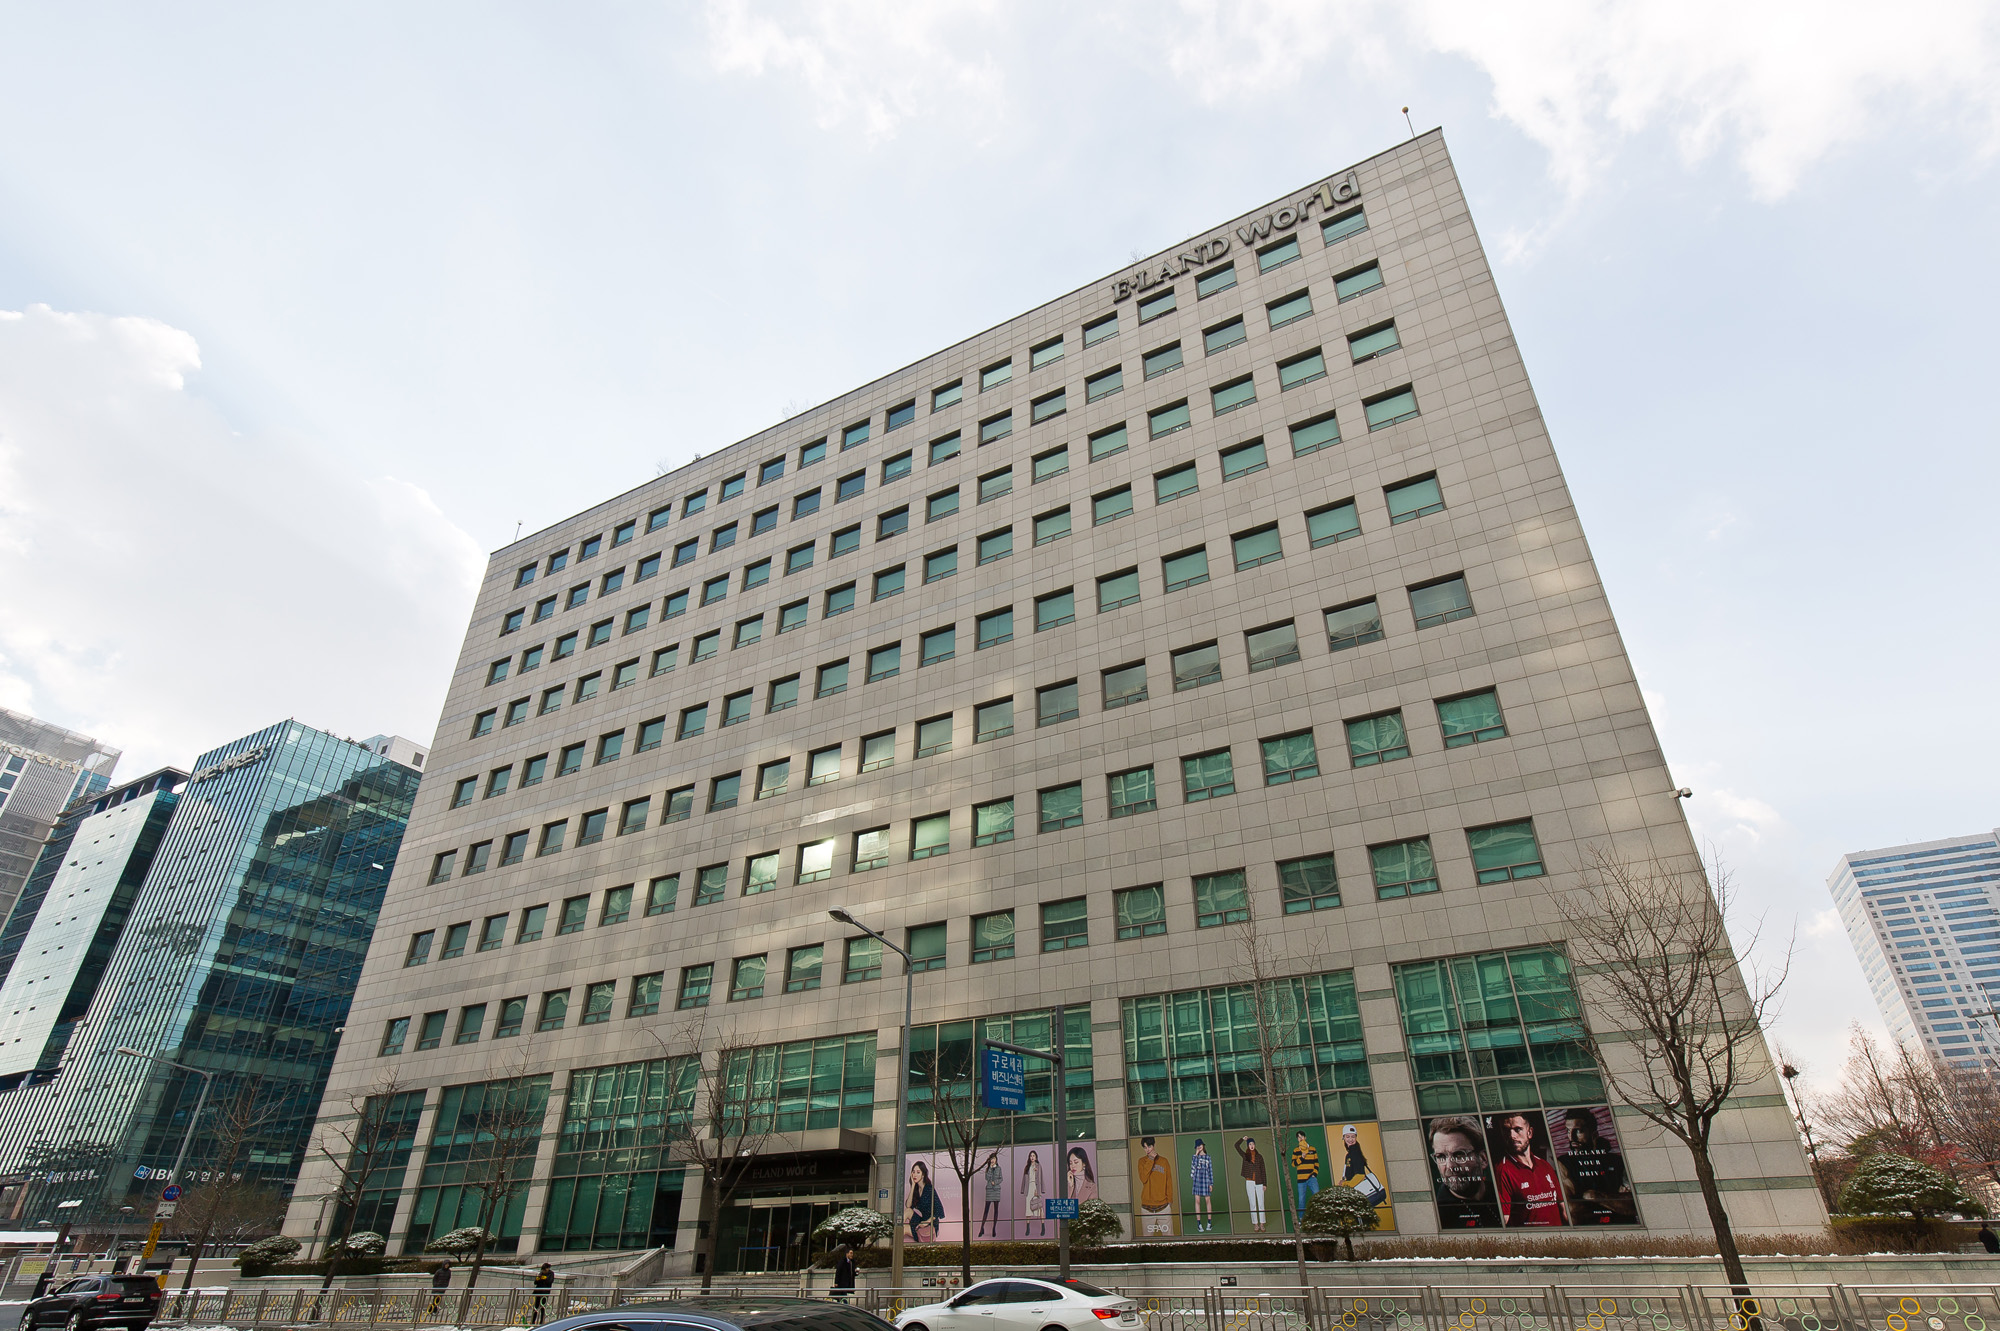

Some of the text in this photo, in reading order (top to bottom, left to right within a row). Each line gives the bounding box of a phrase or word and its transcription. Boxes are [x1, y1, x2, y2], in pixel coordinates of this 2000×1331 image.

[991, 1054, 1022, 1073] 구로세관
[991, 1071, 1023, 1087] 비즈니스센터
[786, 1162, 817, 1176] word
[1526, 1190, 1553, 1202] Standard
[1146, 1224, 1169, 1233] SPAO
